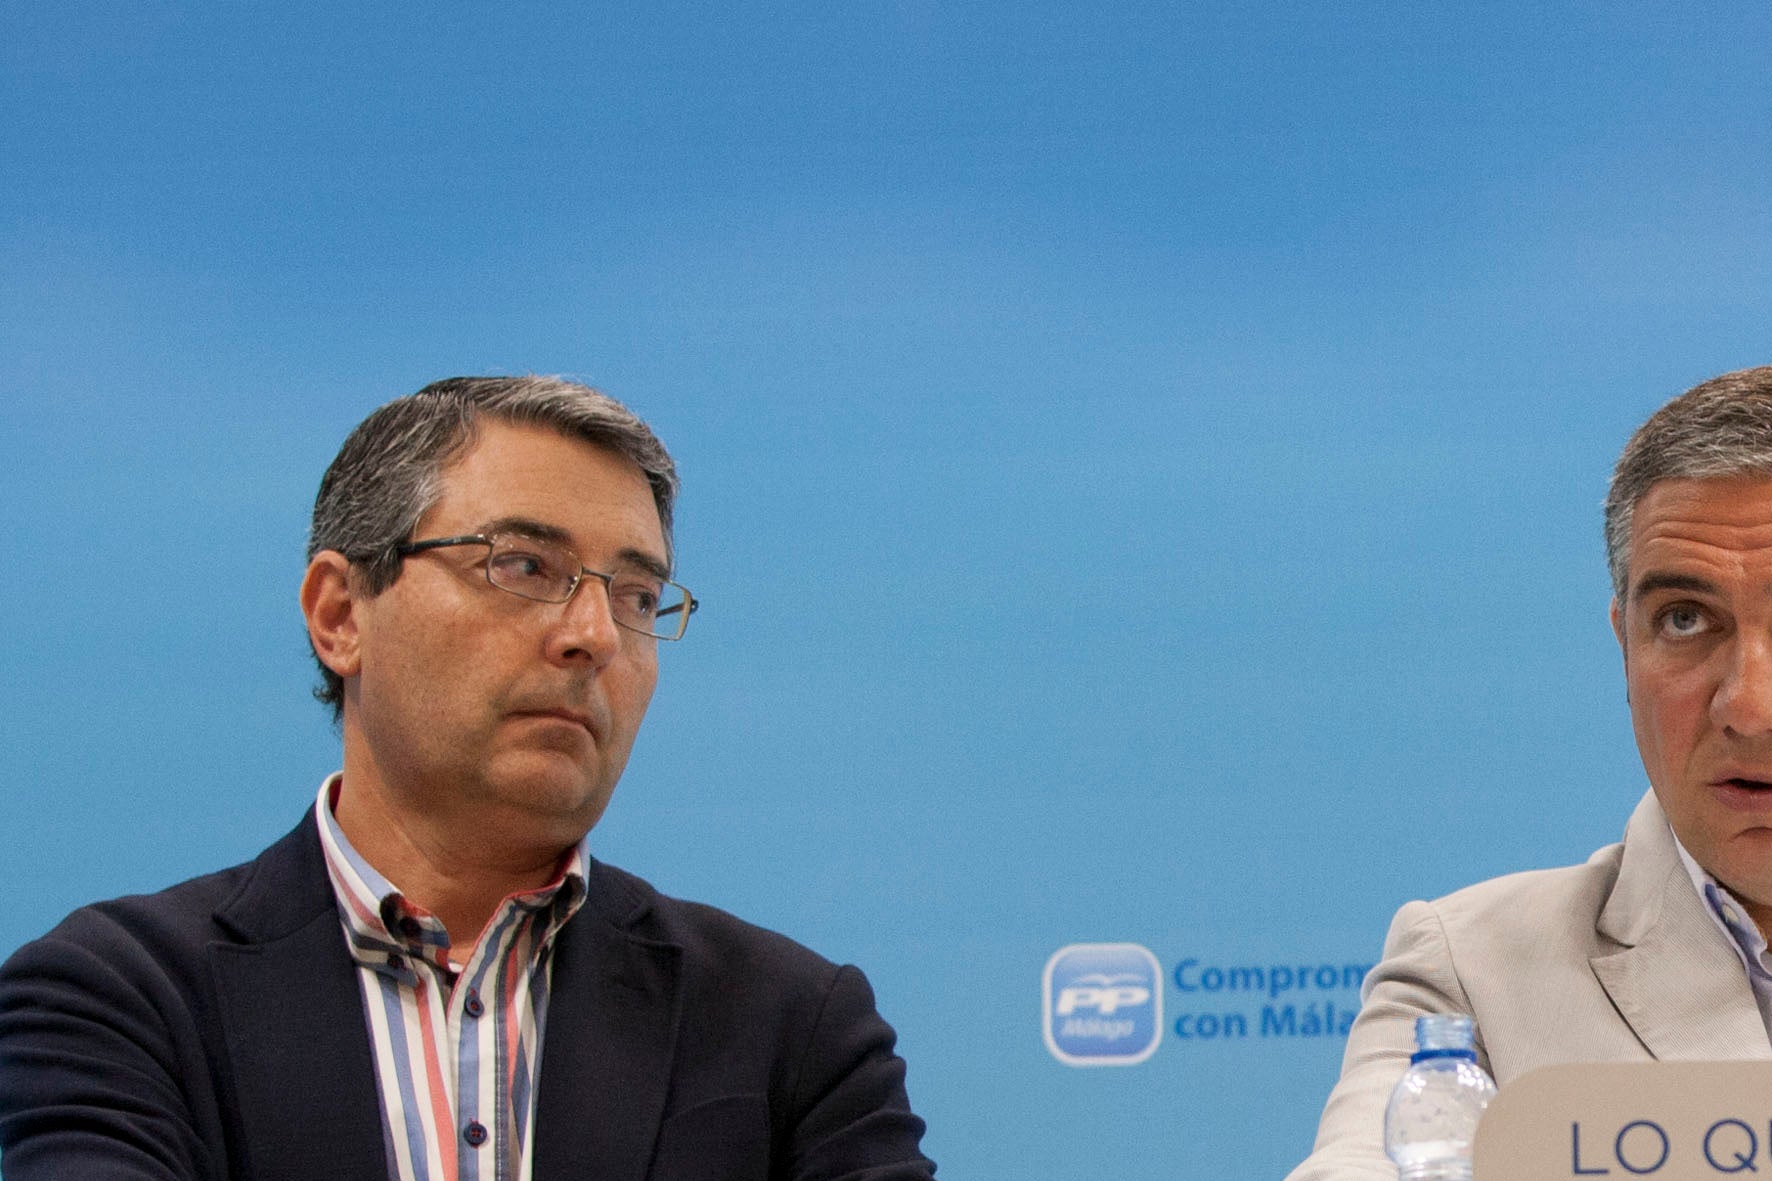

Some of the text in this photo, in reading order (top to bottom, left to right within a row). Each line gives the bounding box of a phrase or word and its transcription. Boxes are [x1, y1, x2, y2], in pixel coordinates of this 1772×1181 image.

[1057, 986, 1149, 1014] PP
[1175, 1012, 1247, 1039] con
[1573, 1120, 1670, 1174] LO
